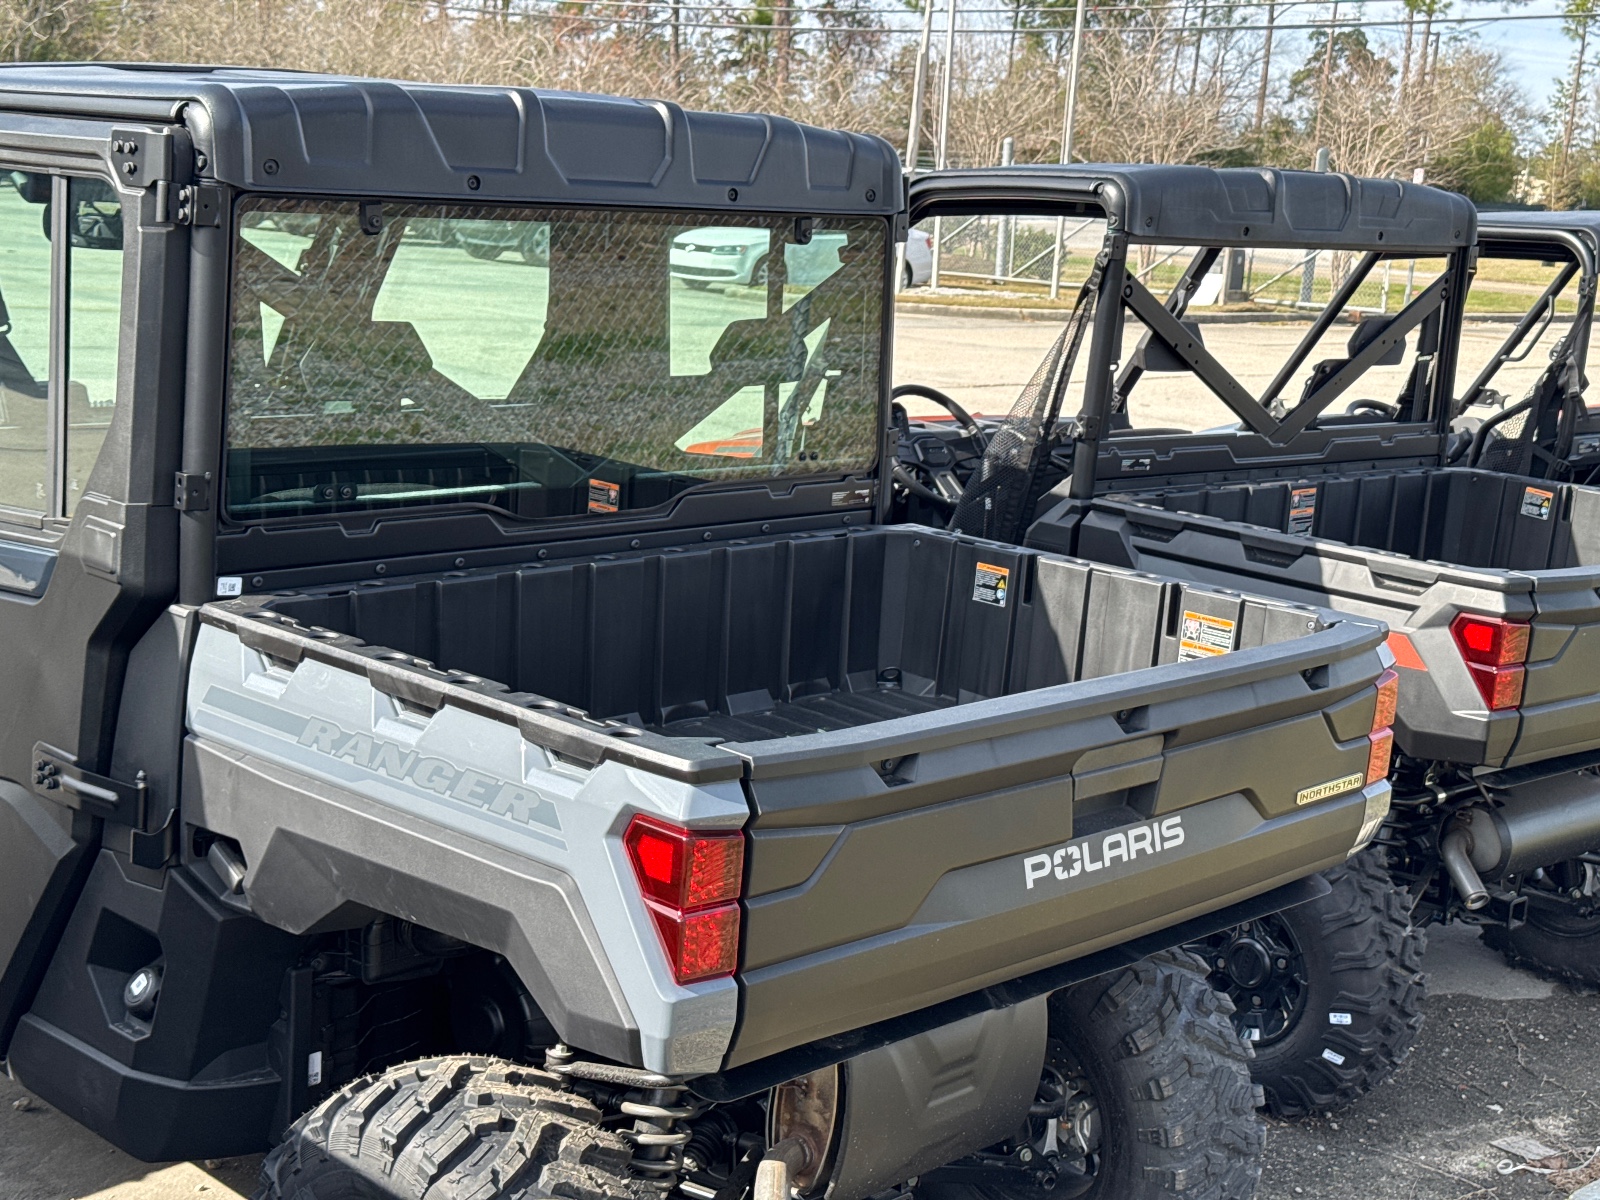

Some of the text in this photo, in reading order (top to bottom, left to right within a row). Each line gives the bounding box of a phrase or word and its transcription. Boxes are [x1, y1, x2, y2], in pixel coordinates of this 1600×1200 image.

[297, 715, 542, 825] RANGER
[1301, 777, 1360, 802] NORTHSTAR
[1023, 815, 1185, 890] POLARIS
